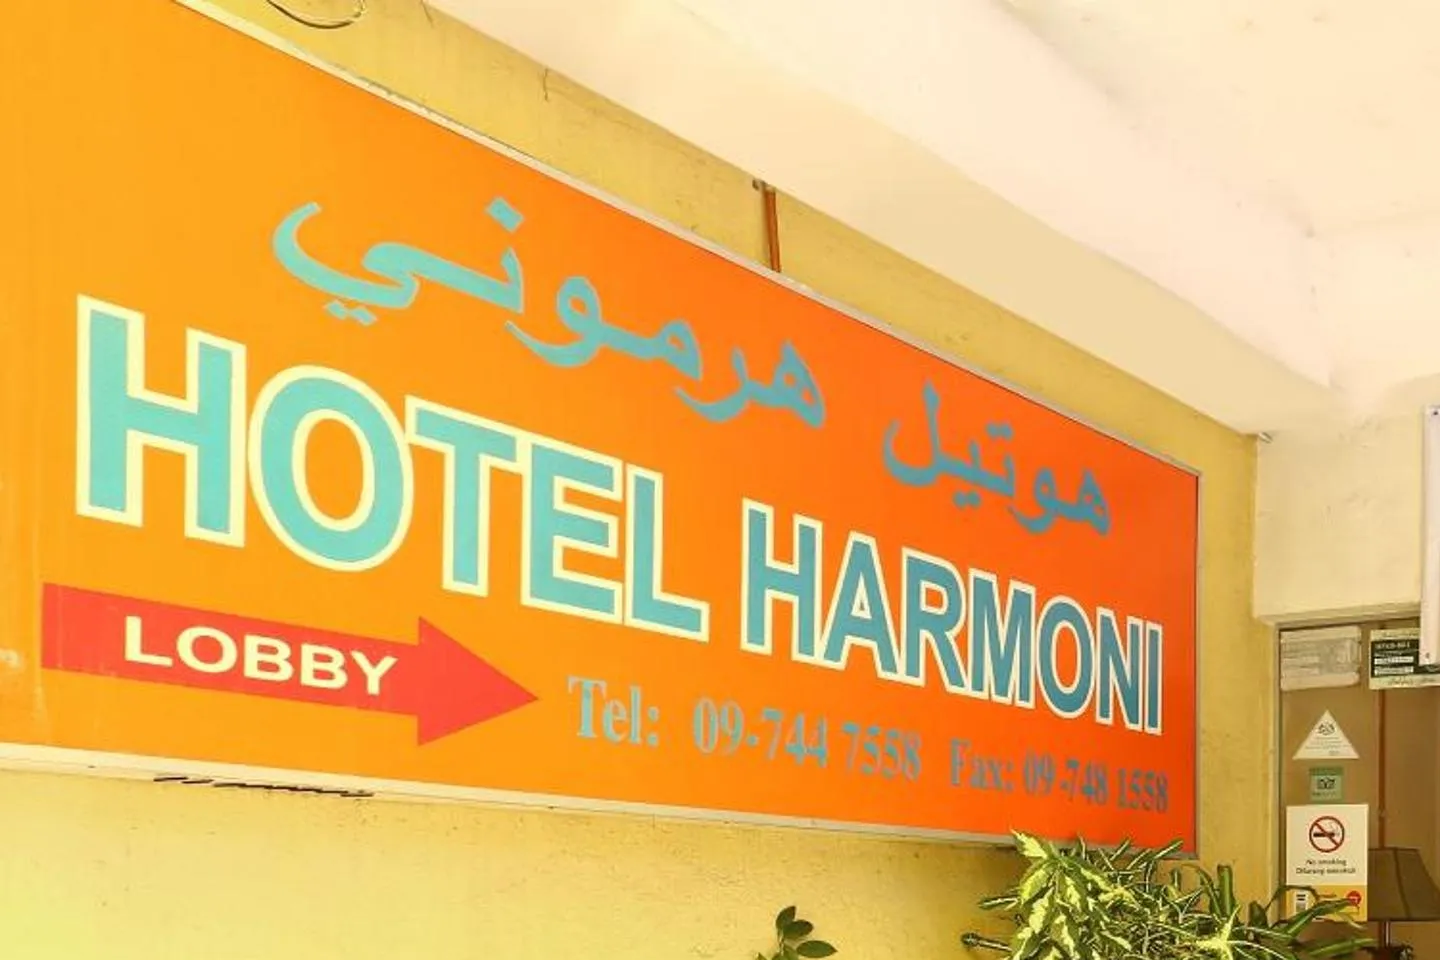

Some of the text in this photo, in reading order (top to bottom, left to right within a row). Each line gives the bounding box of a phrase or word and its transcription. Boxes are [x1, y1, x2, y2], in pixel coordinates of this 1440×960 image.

[272, 196, 1111, 535] هوتيل هرموني
[76, 293, 1163, 735] HOTEL HARMONI
[124, 615, 397, 696] LOBBY
[568, 675, 660, 747] Tel:
[692, 696, 828, 768] 09-744
[841, 721, 922, 781] 7558
[951, 739, 1014, 793] Fax:
[1117, 767, 1169, 813] 1558
